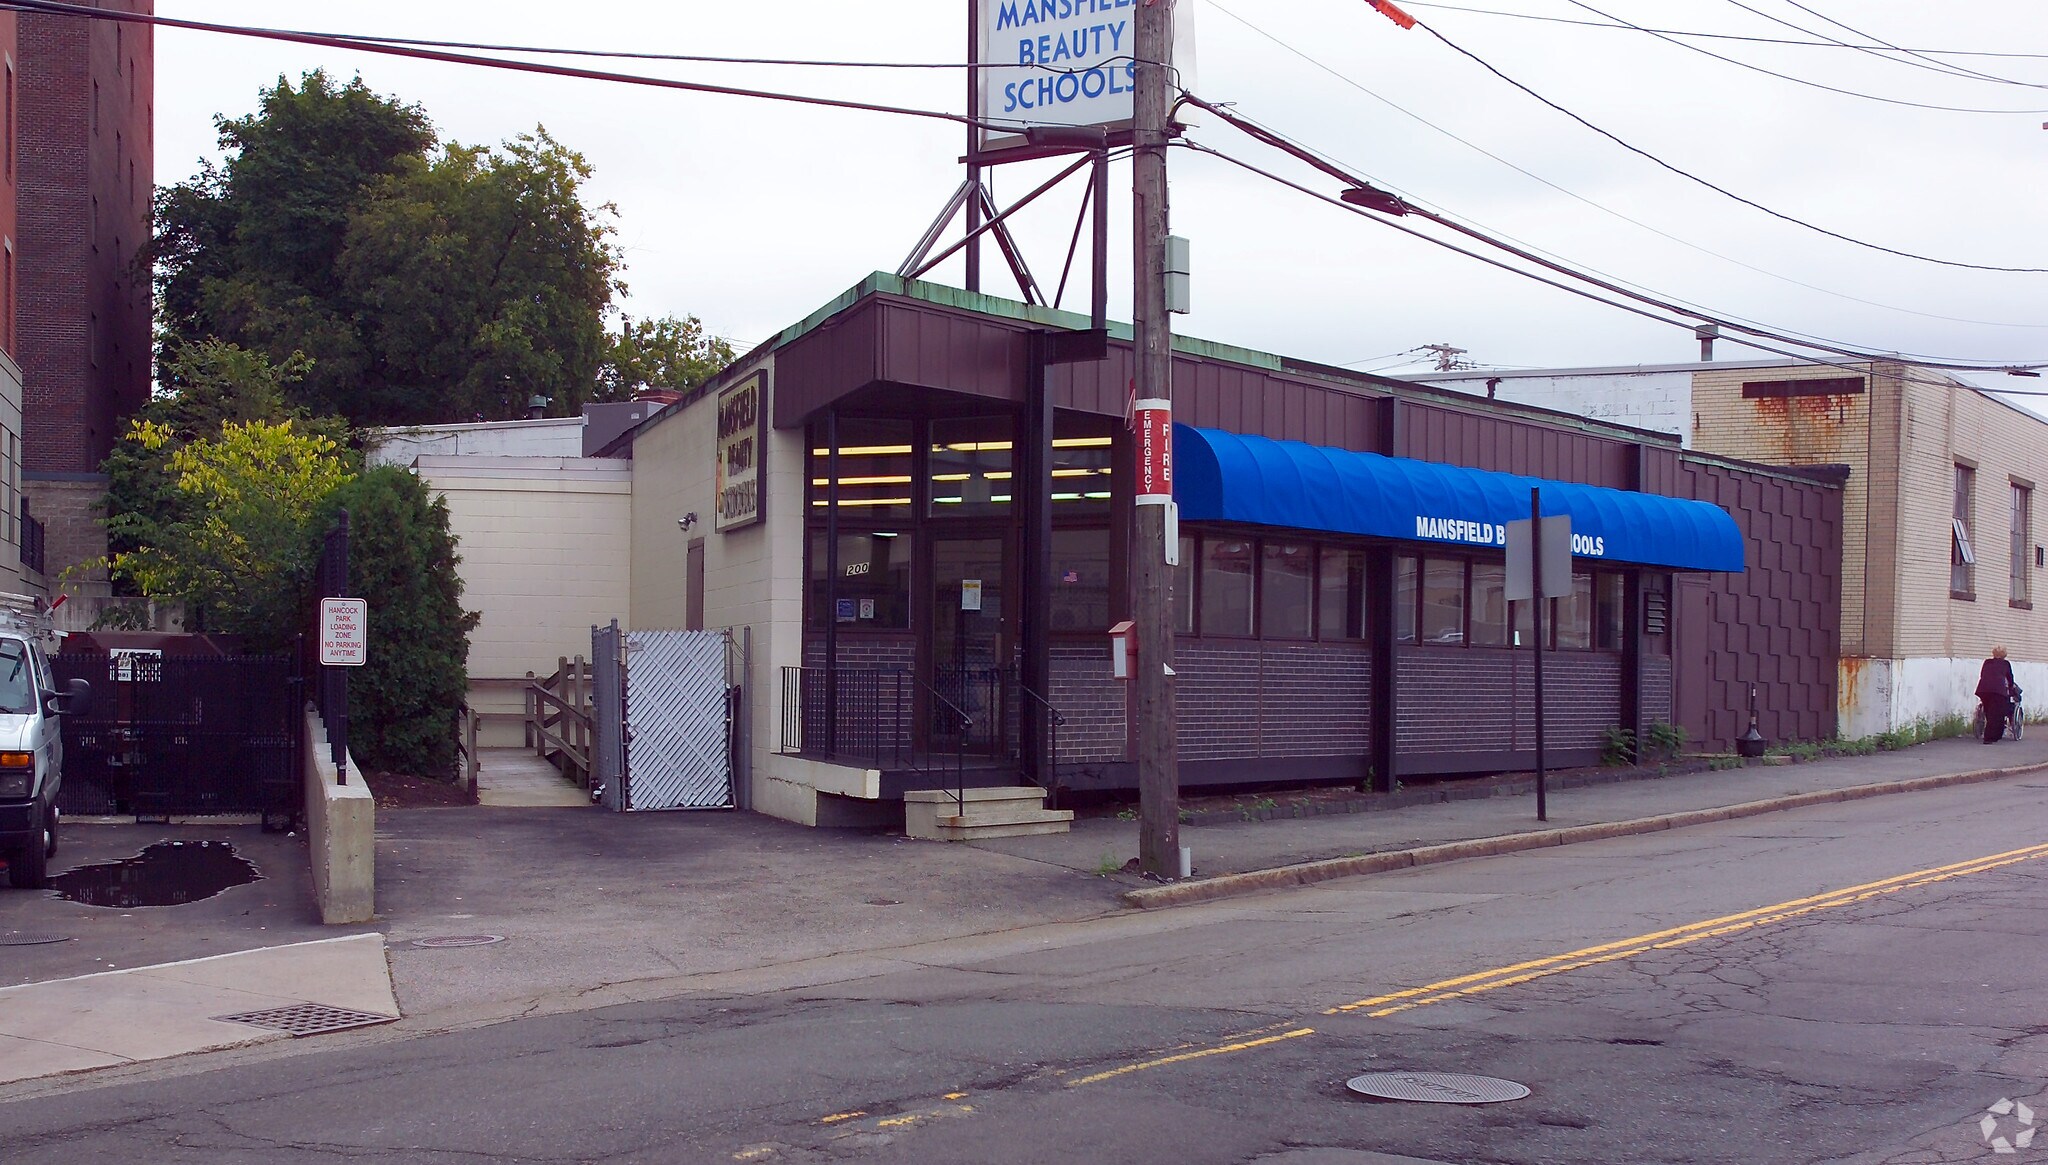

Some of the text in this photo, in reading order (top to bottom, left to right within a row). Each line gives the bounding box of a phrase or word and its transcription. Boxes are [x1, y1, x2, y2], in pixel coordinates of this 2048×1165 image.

[1019, 21, 1126, 67] BEAUTY
[1004, 61, 1134, 112] SCHOOLS
[1143, 410, 1152, 493] EMERGENCY
[1162, 423, 1170, 481] FIRE
[1416, 516, 1493, 545] MANSFIELD
[1570, 534, 1604, 556] OOLS
[847, 563, 869, 575] 200
